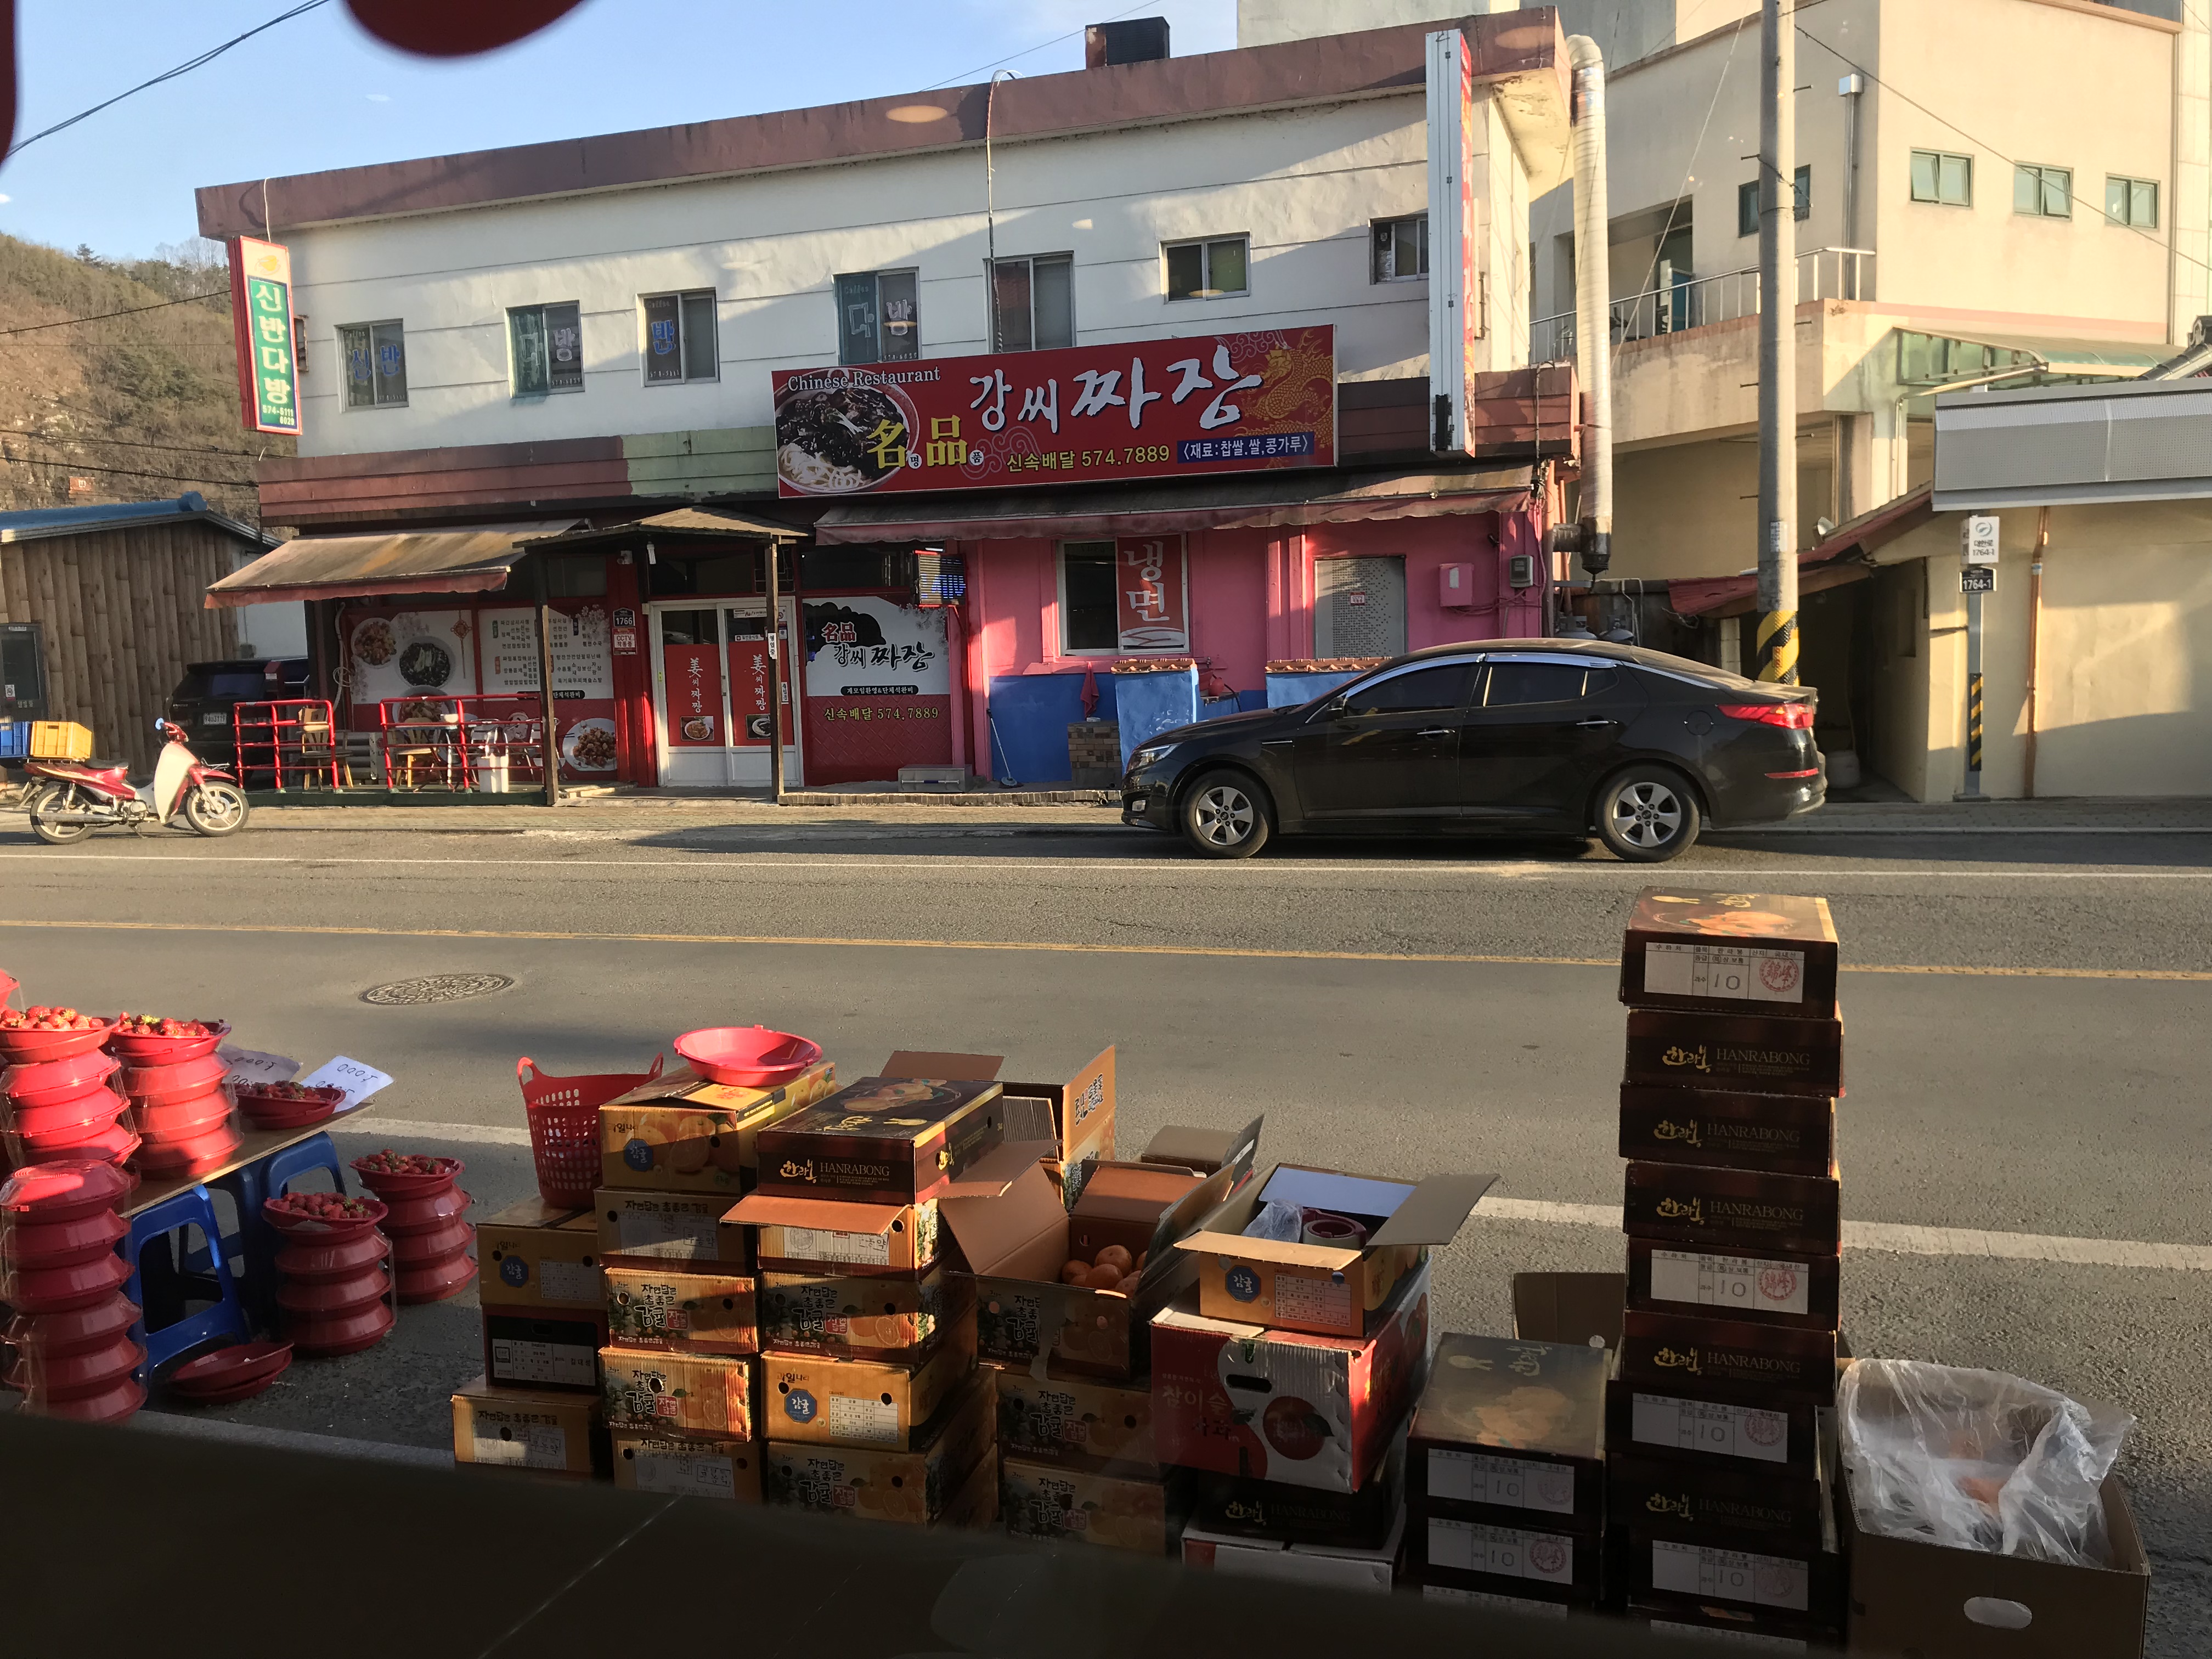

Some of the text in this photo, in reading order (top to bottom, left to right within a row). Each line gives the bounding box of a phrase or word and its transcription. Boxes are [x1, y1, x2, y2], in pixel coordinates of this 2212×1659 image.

[255, 285, 292, 404] 신반다방
[651, 320, 676, 354] 반
[788, 366, 941, 392] Chinese Restaurant
[970, 345, 1262, 433] 강씨 짜장
[262, 405, 294, 417] 574-5111
[279, 416, 295, 425] 6029
[867, 419, 907, 469] 名
[926, 415, 968, 467] 品
[1008, 445, 1170, 473] 신속배달 574.7889
[1124, 540, 1170, 622] 냉면
[1963, 579, 1991, 589] 1764-1
[822, 621, 857, 643] 名品
[834, 641, 934, 672] 강씨 짜장
[824, 707, 939, 721] 신속배달 574.7889
[1714, 973, 1741, 991] 10
[1662, 1045, 1712, 1073] 한라봉
[1717, 1047, 1810, 1065] HANRABONG
[1654, 1119, 1702, 1148] 한라봉
[1707, 1123, 1800, 1143] HANRABONG
[630, 1148, 647, 1164] 감귤
[780, 1159, 817, 1183] 한라봉
[820, 1161, 890, 1177] HANRABONG
[1656, 1197, 1705, 1226] 한라봉
[1710, 1201, 1803, 1221] HANRABONG
[506, 1263, 523, 1279] 감귤
[641, 1284, 677, 1295] 자연담은
[800, 1285, 838, 1298] 자연담은
[1233, 1274, 1253, 1294] 감귤
[634, 1305, 666, 1328] 감귤
[791, 1307, 825, 1332] 감귤
[1006, 1317, 1040, 1344] 감귤
[1654, 1347, 1801, 1375] 한라봉 HANRABONG
[624, 1391, 657, 1414] 감귤
[791, 1397, 810, 1414] 감귤
[1038, 1390, 1076, 1405] 자연담은
[1162, 1384, 1228, 1417] 참이슬
[1029, 1412, 1063, 1438] 감귤
[807, 1458, 845, 1471] 자연담은
[798, 1480, 832, 1504] 감귤
